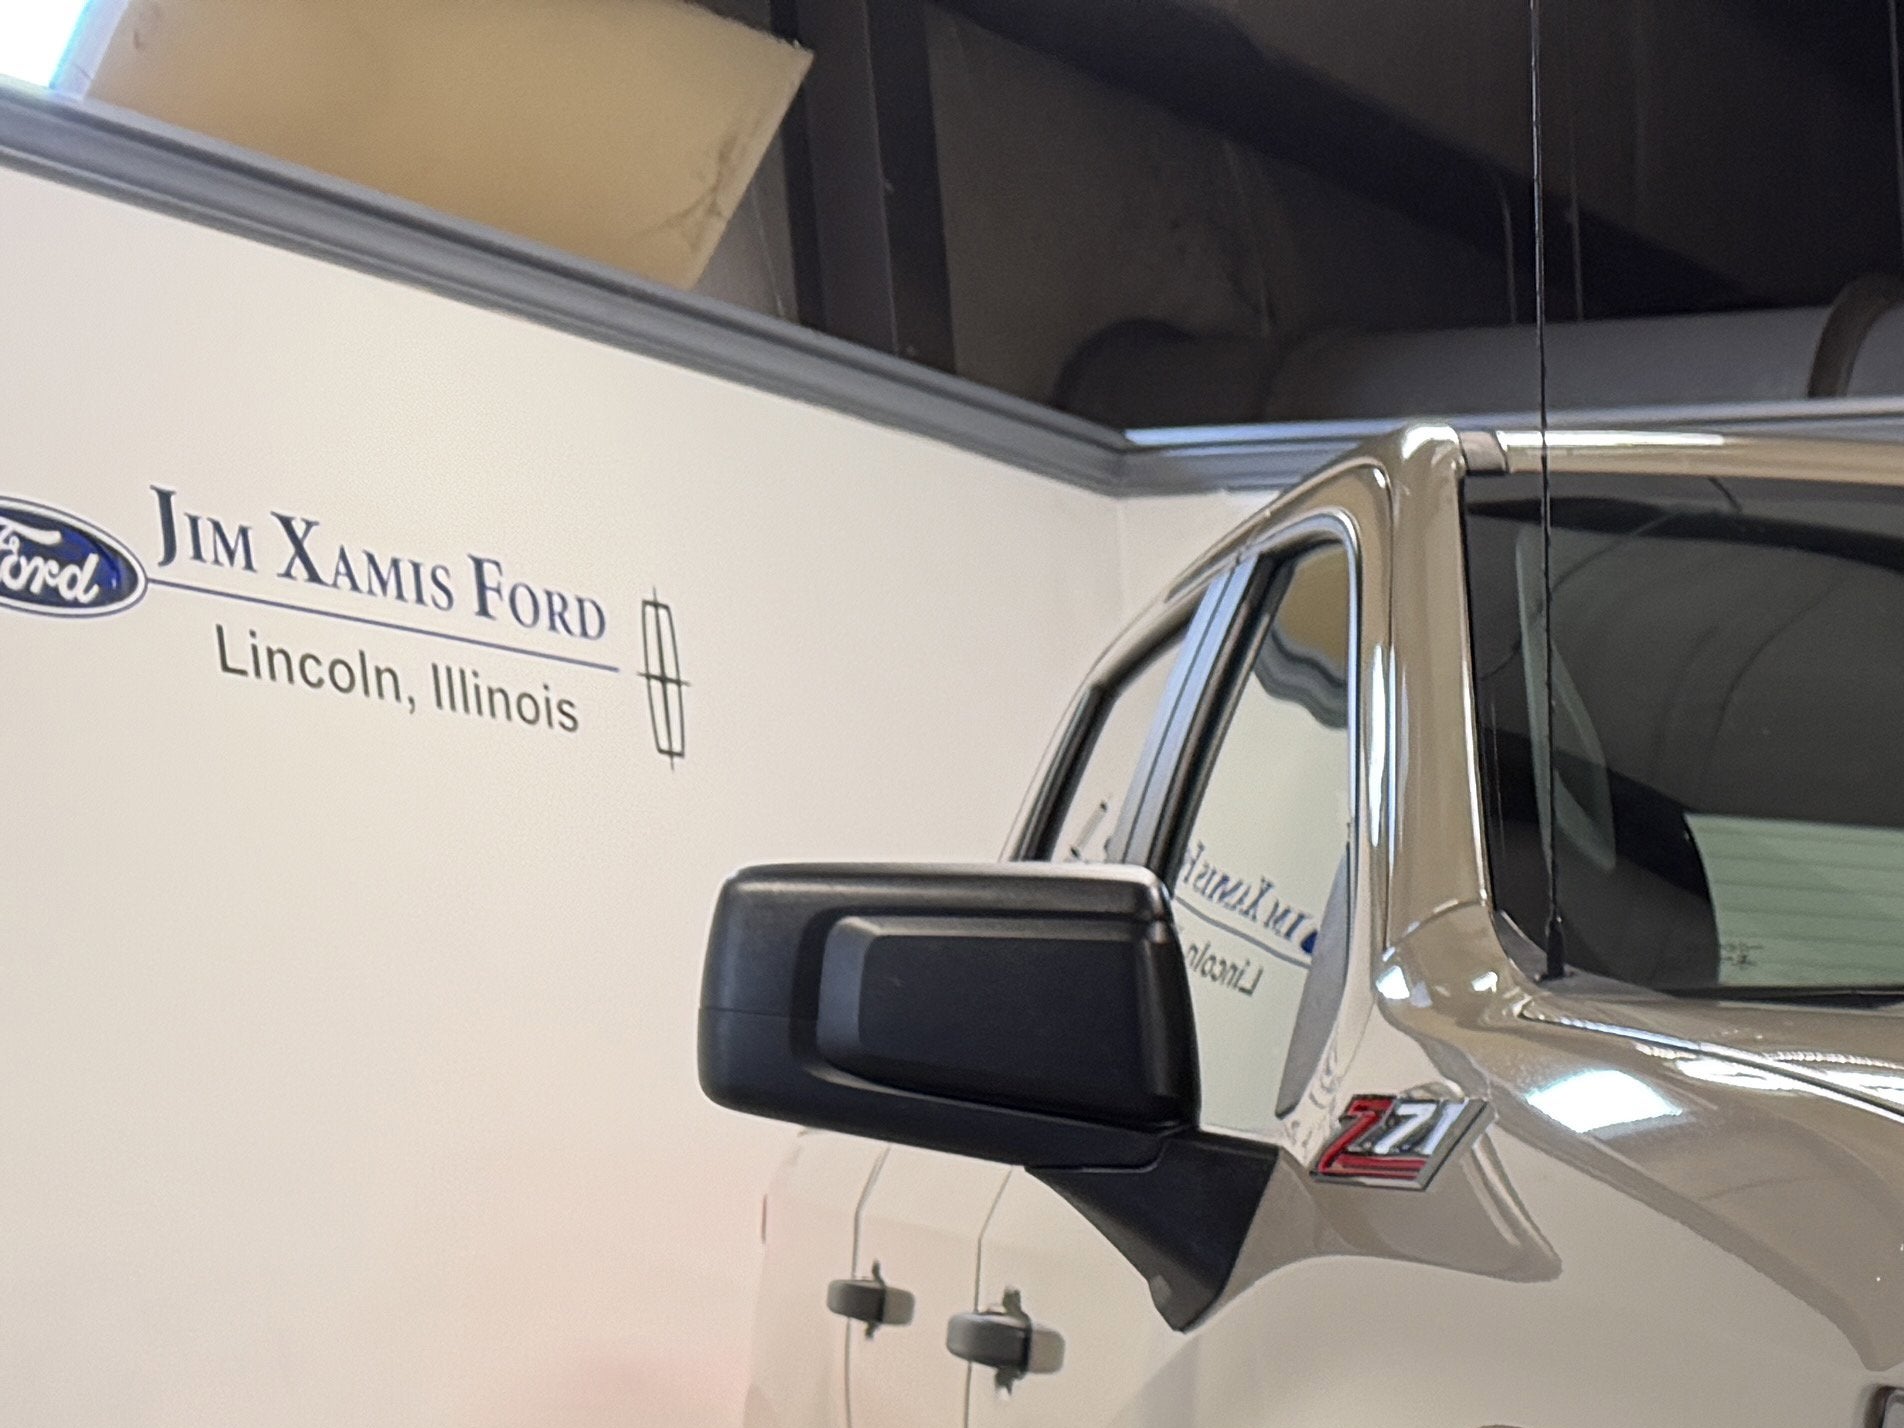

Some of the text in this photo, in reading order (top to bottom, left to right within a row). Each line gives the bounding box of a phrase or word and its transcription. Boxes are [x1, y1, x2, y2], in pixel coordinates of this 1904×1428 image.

[149, 484, 608, 641] JIM XAMIS FORD
[214, 623, 580, 733] Lincoln, Illinois
